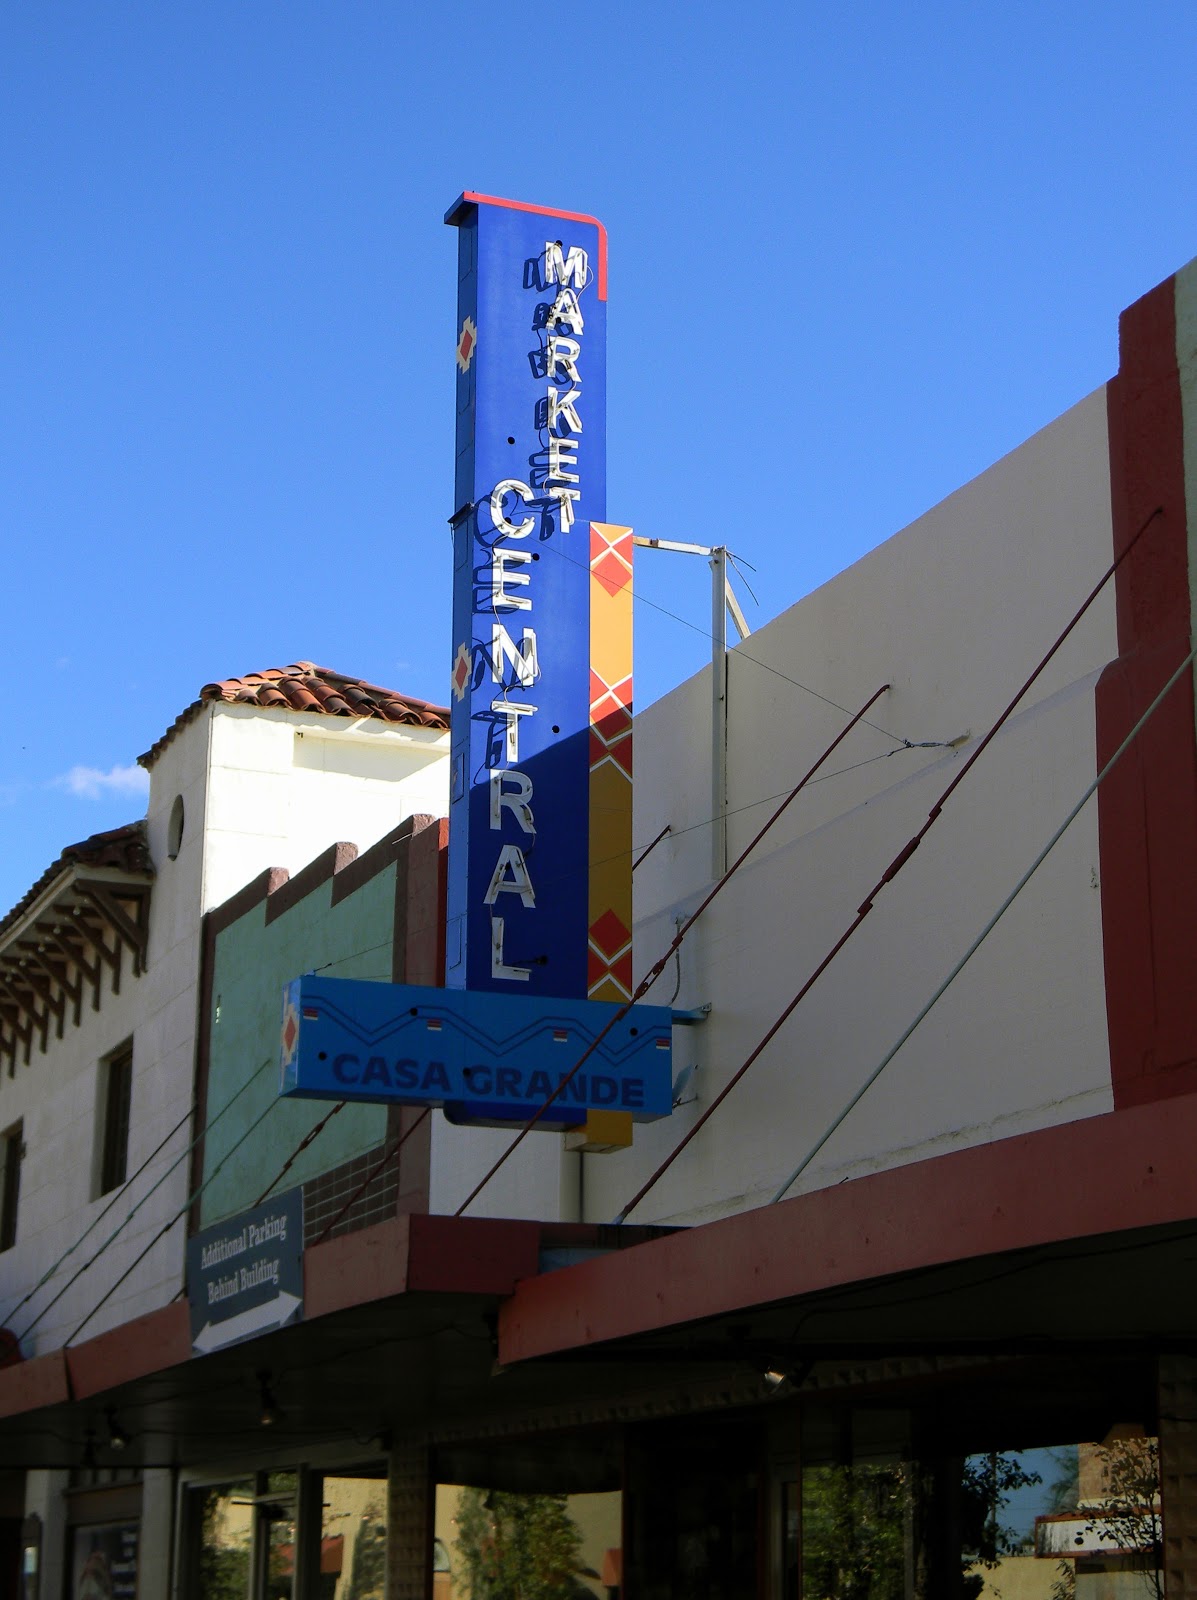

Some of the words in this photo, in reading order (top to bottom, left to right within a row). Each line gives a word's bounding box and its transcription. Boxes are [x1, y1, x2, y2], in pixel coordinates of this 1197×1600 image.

[545, 241, 588, 534] MARKET
[484, 479, 540, 981] CENTRAL
[332, 1053, 451, 1093] CASA
[465, 1065, 645, 1107] GRANDE
[201, 1228, 247, 1270] Additional
[249, 1215, 288, 1248] Parking
[207, 1272, 239, 1304] Behind
[240, 1259, 280, 1291] Building
